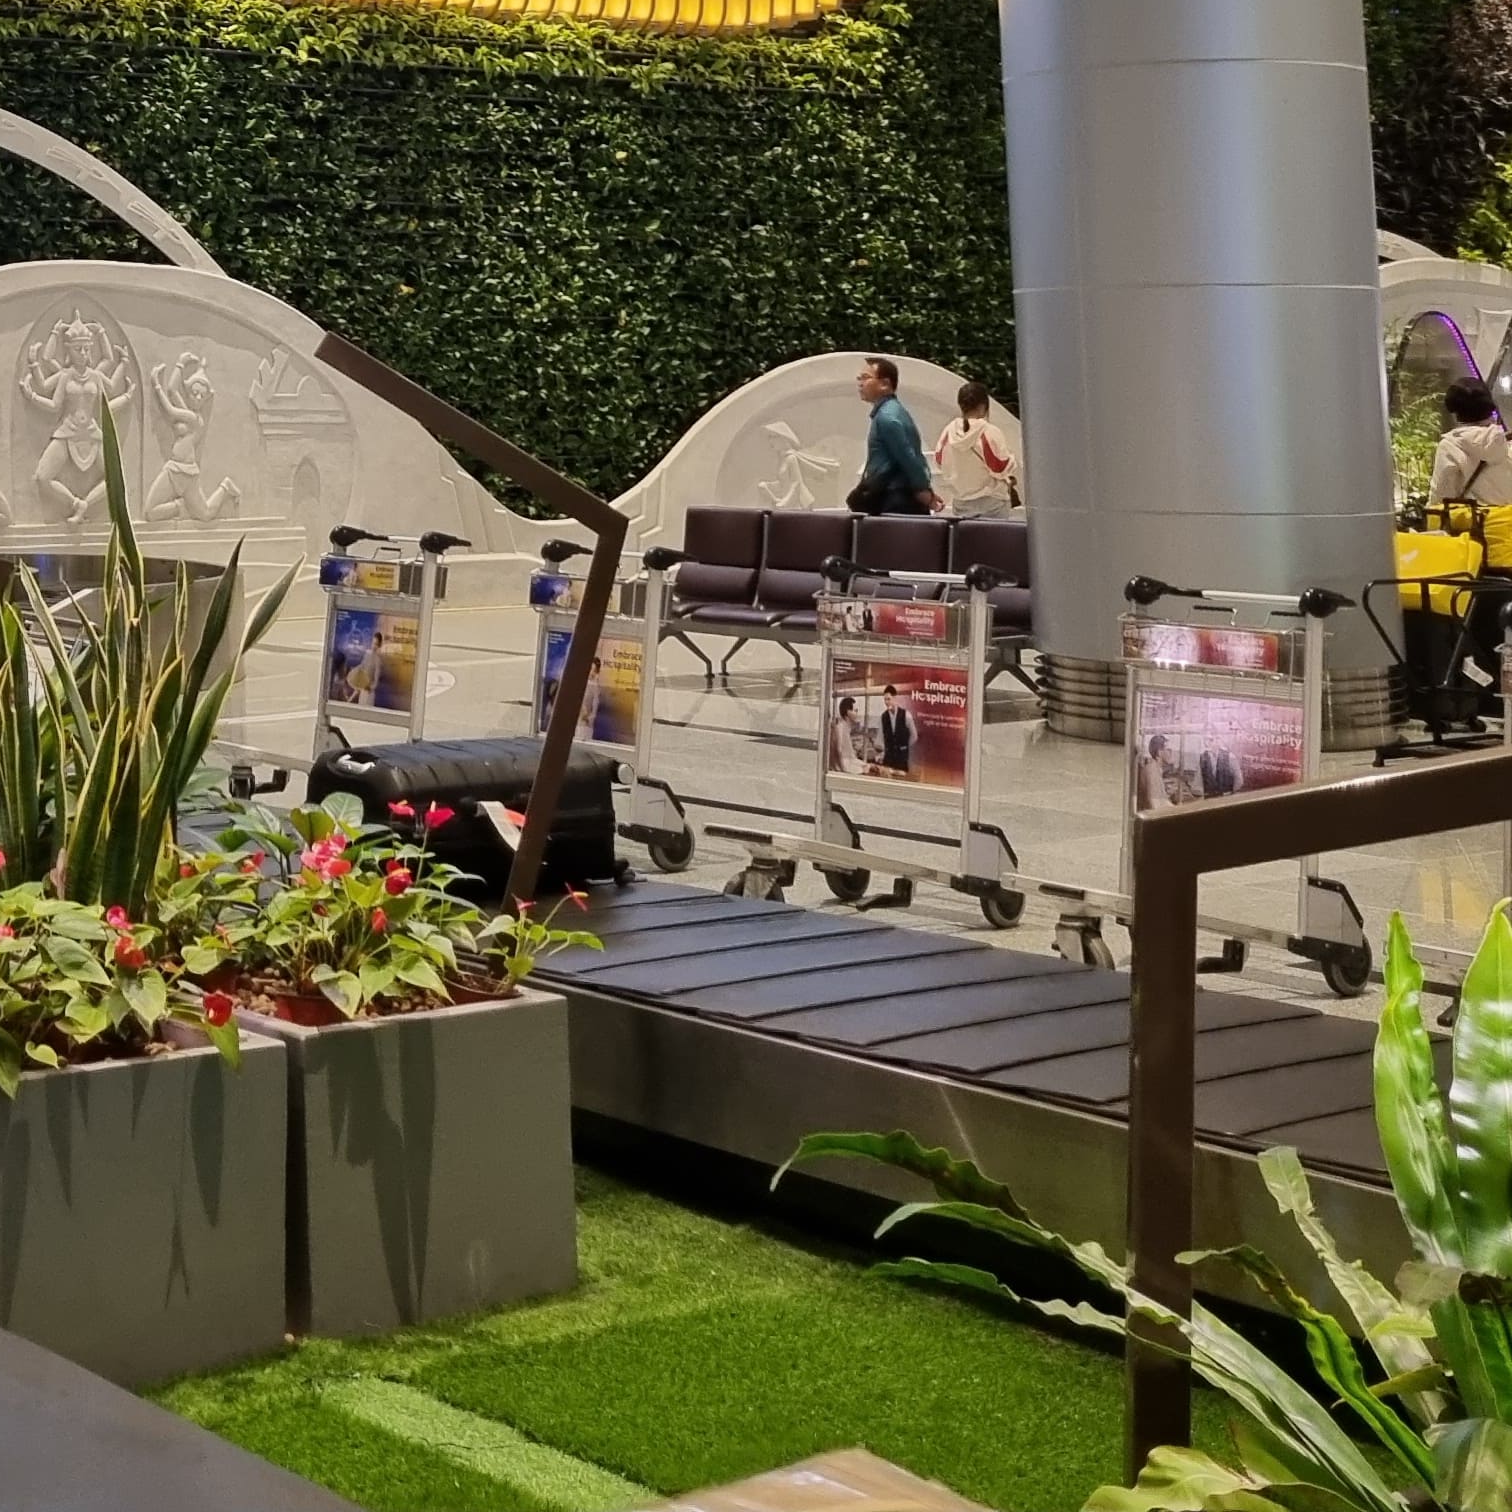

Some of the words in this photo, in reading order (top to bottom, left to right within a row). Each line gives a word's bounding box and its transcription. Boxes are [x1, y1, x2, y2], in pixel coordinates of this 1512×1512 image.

[924, 679, 966, 694] Embrace
[911, 690, 966, 708] Hospitality
[1252, 719, 1302, 734] Embrace
